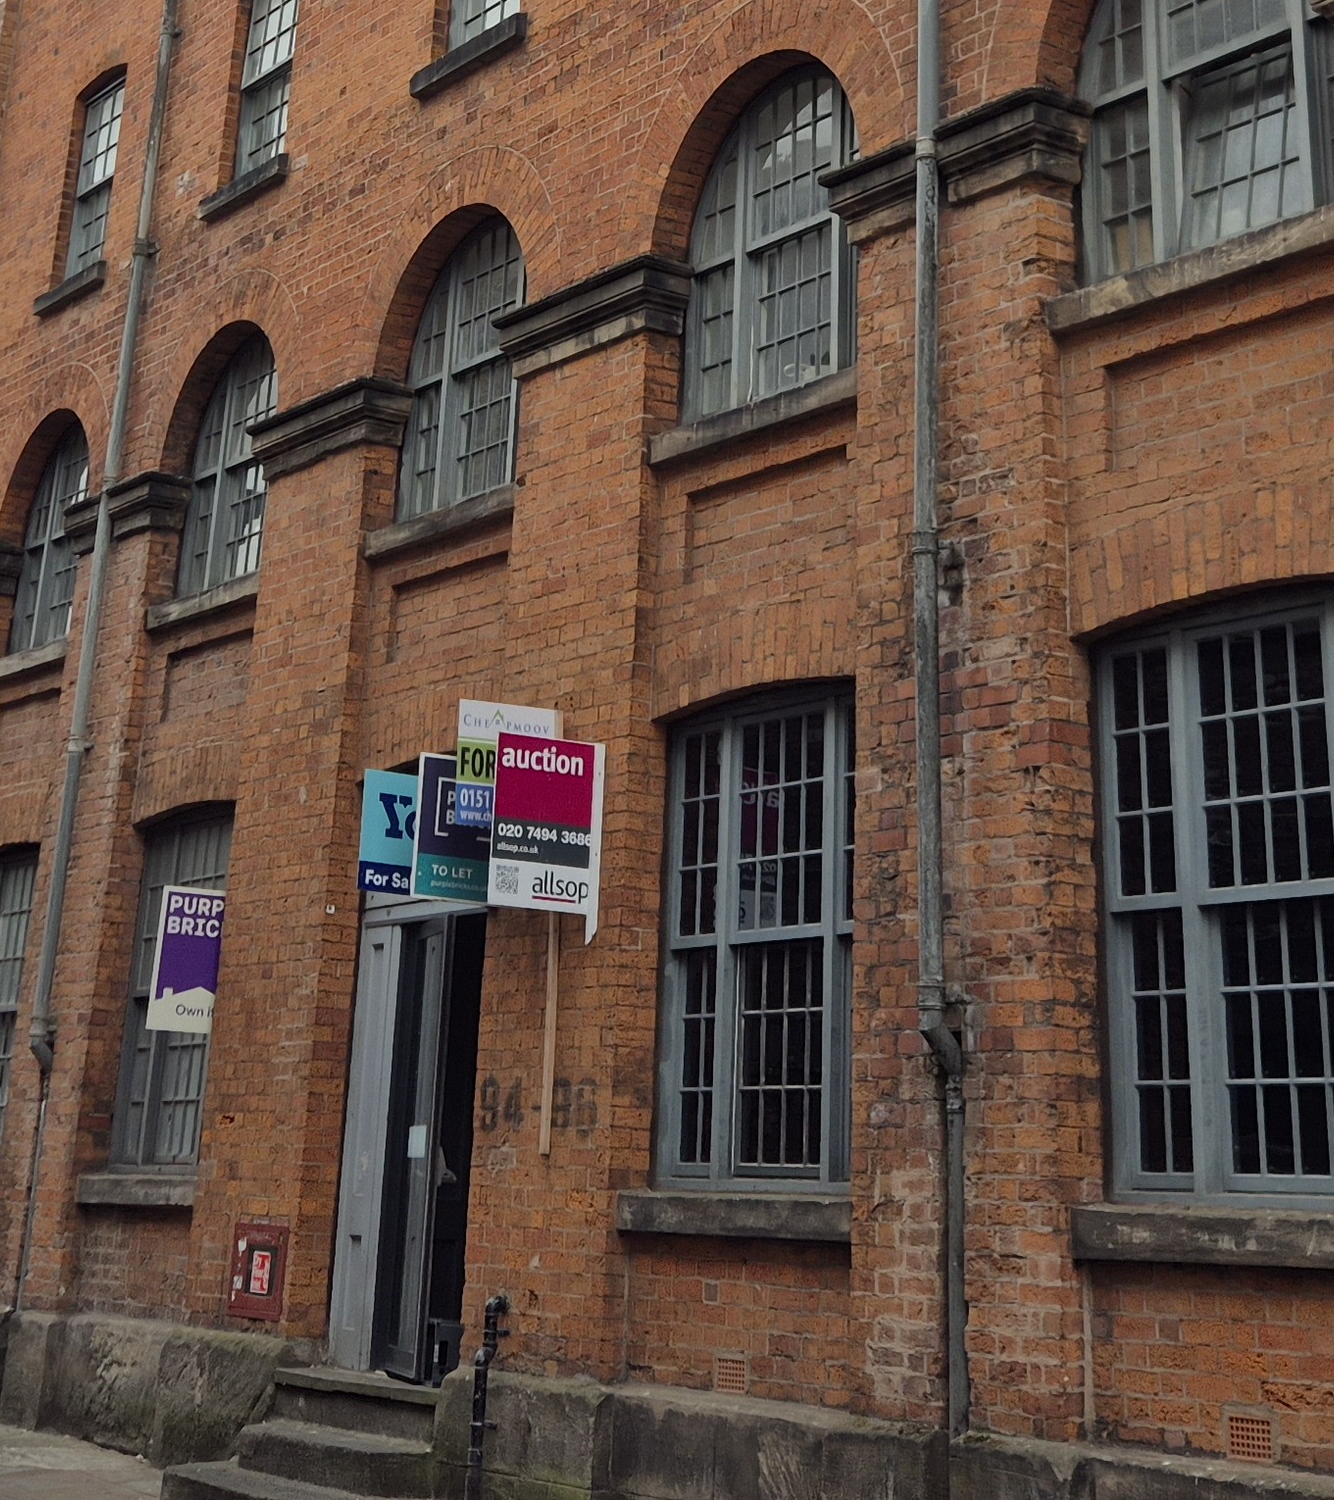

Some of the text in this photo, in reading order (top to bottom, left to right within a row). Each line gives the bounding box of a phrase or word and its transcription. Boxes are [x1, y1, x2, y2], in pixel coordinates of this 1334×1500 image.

[460, 746, 496, 779] FOR
[502, 746, 584, 776] auction
[460, 788, 490, 808] 0151
[497, 823, 591, 847] 020 7494 3686
[496, 841, 539, 854] allsop.co.uk
[365, 869, 409, 889] For Sa
[431, 864, 473, 879] TO LET
[532, 870, 588, 904] allsop
[169, 895, 224, 917] PURP
[167, 915, 220, 938] BRIC
[175, 1004, 203, 1017] Own
